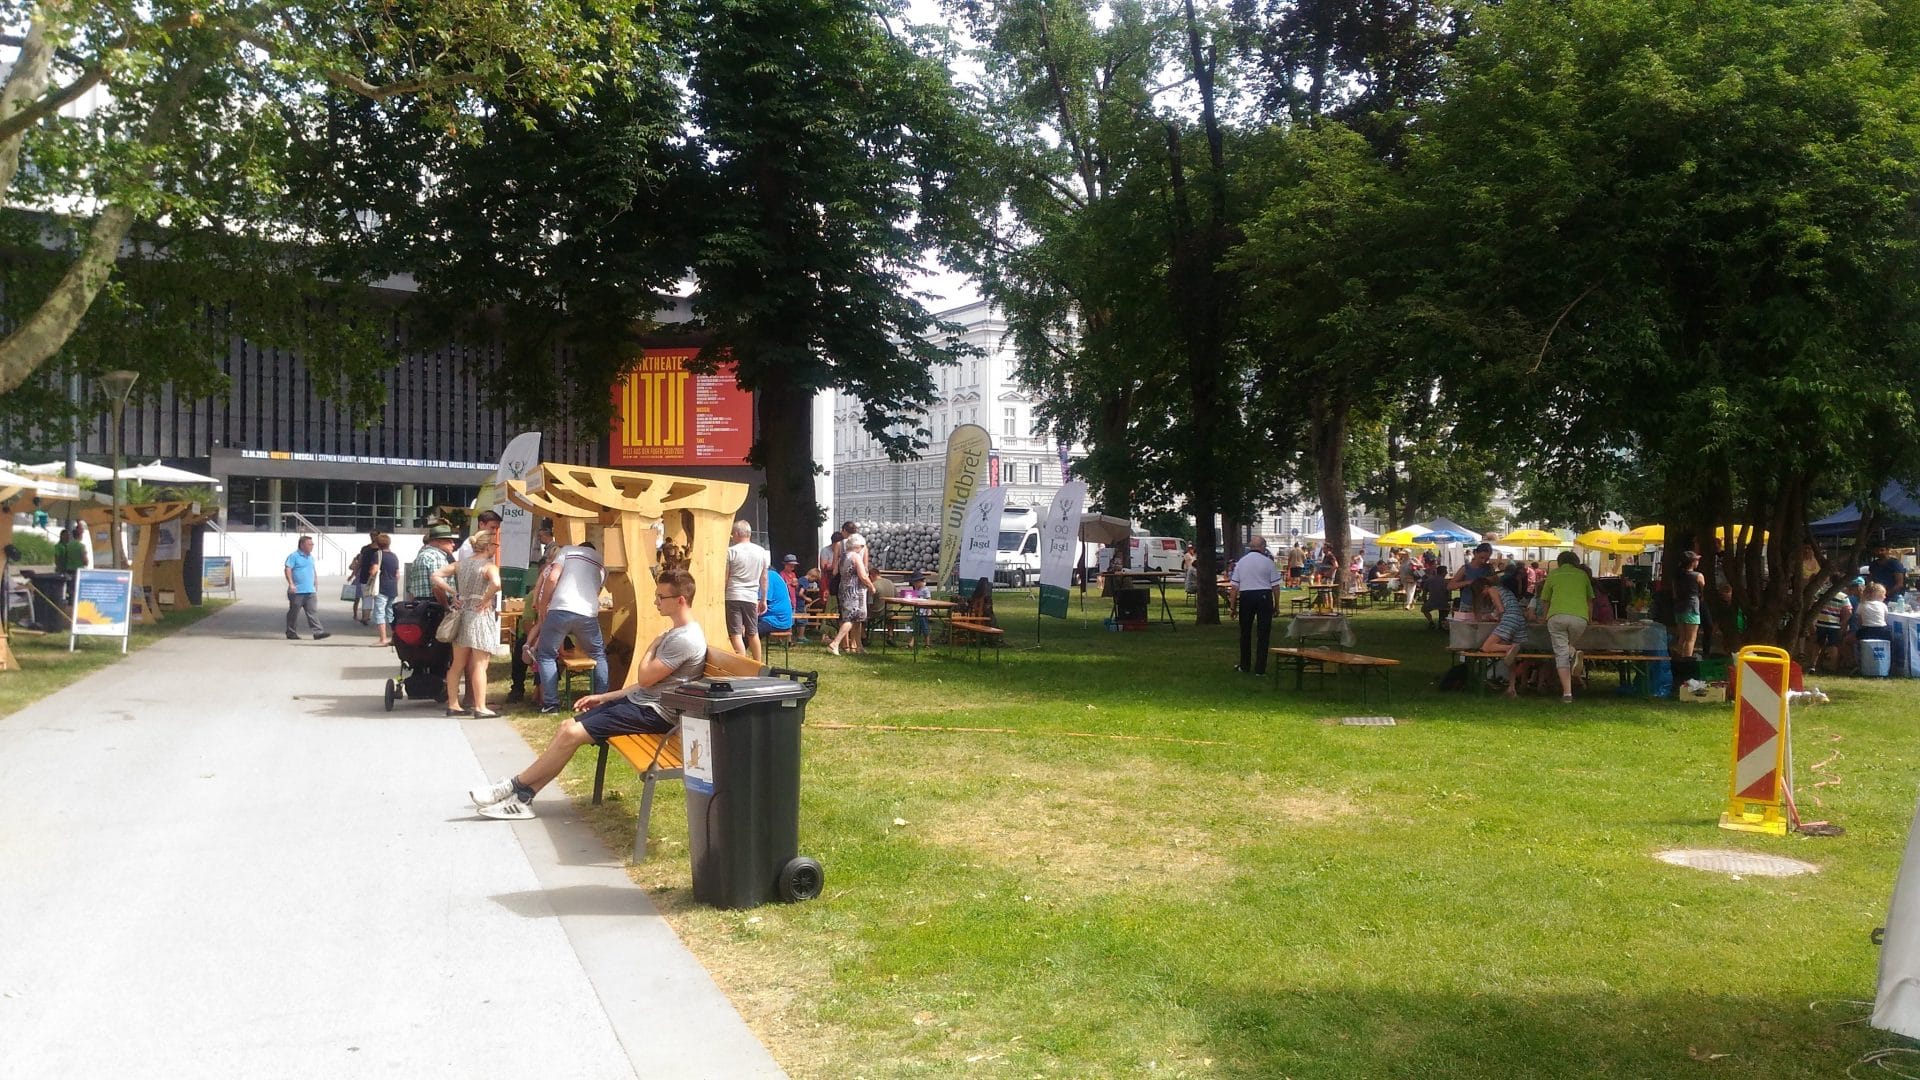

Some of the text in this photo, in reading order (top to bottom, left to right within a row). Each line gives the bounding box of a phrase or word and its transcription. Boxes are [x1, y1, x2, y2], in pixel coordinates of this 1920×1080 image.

[948, 448, 983, 529] wildbret
[502, 505, 524, 521] Jagd
[969, 537, 990, 550] Jagd
[1049, 538, 1069, 553] Jagd
